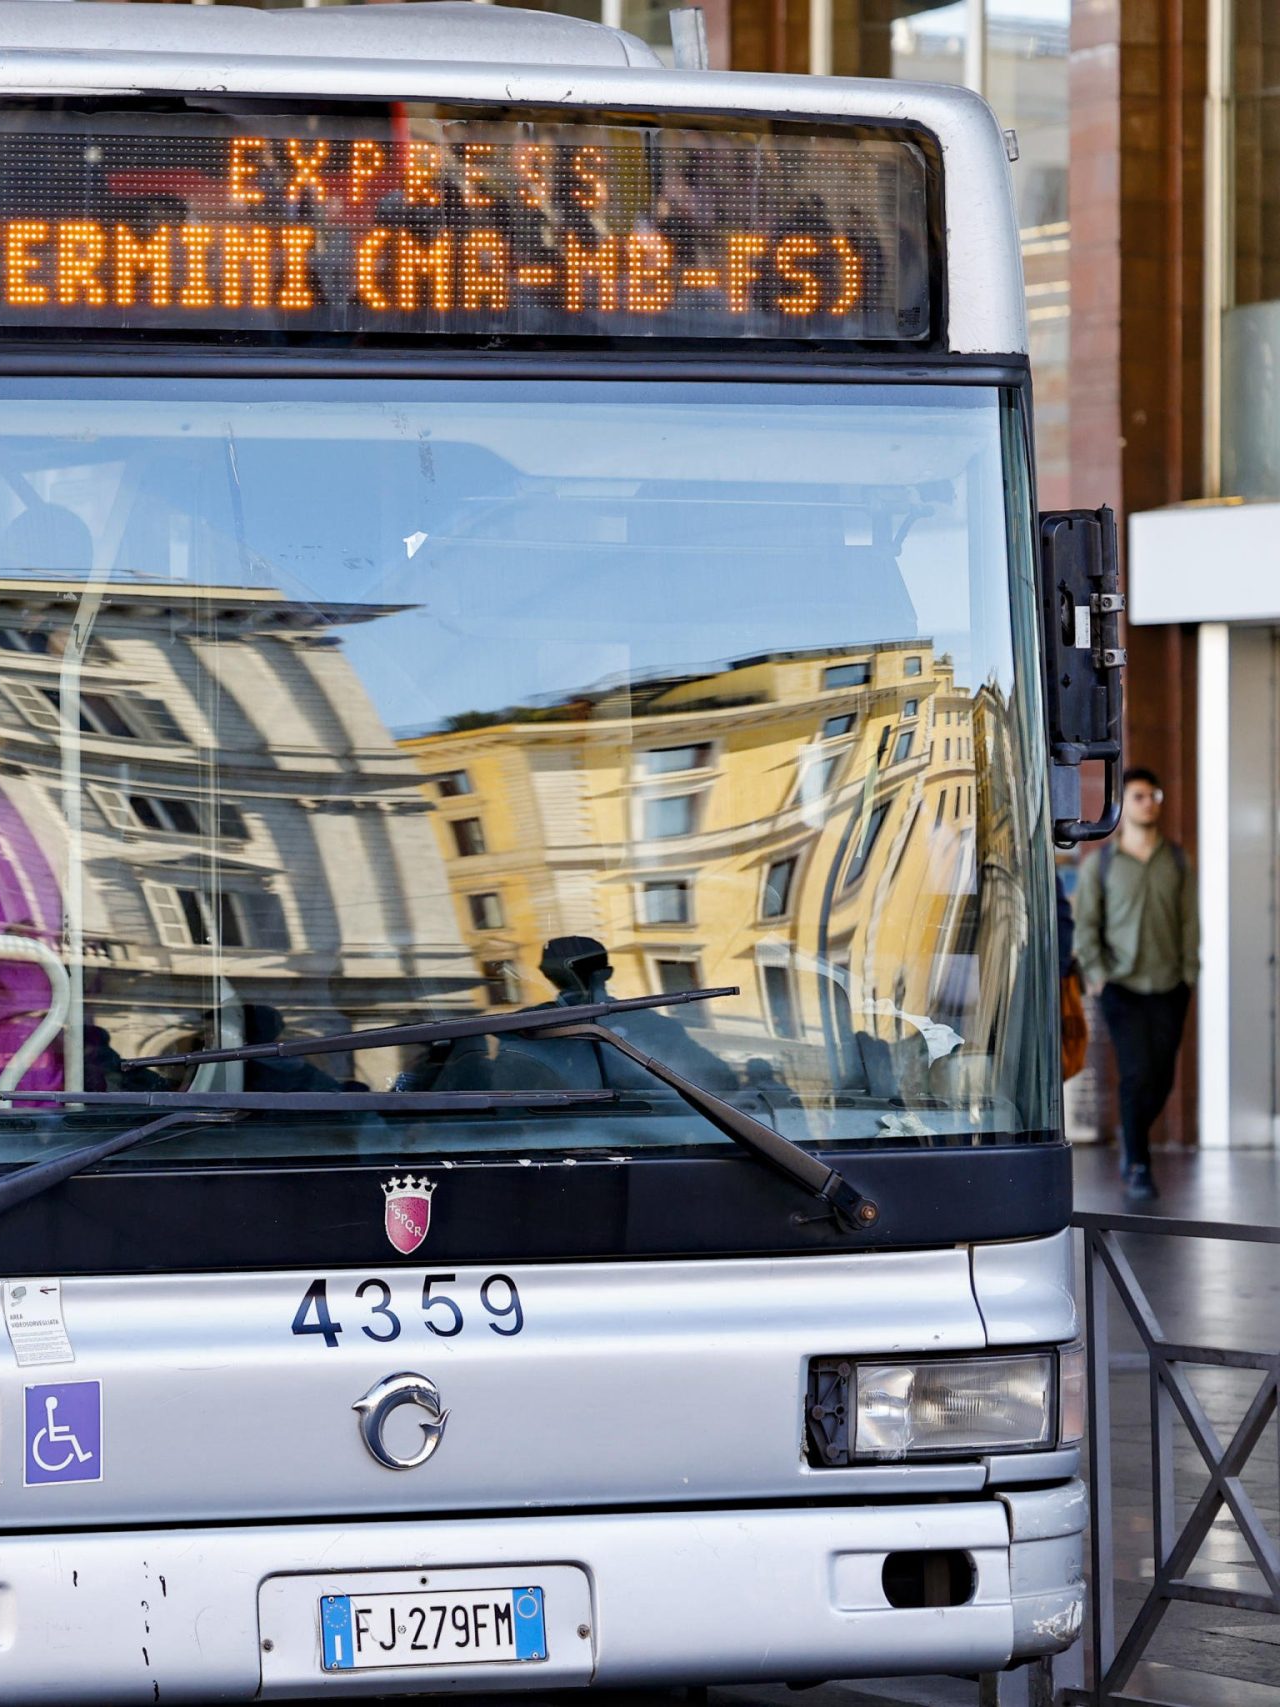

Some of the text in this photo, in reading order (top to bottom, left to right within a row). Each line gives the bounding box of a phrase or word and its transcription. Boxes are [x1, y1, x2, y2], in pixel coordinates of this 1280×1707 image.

[230, 137, 604, 207] EXPRESS
[394, 1208, 423, 1237] SPQR
[291, 1273, 524, 1347] 4359
